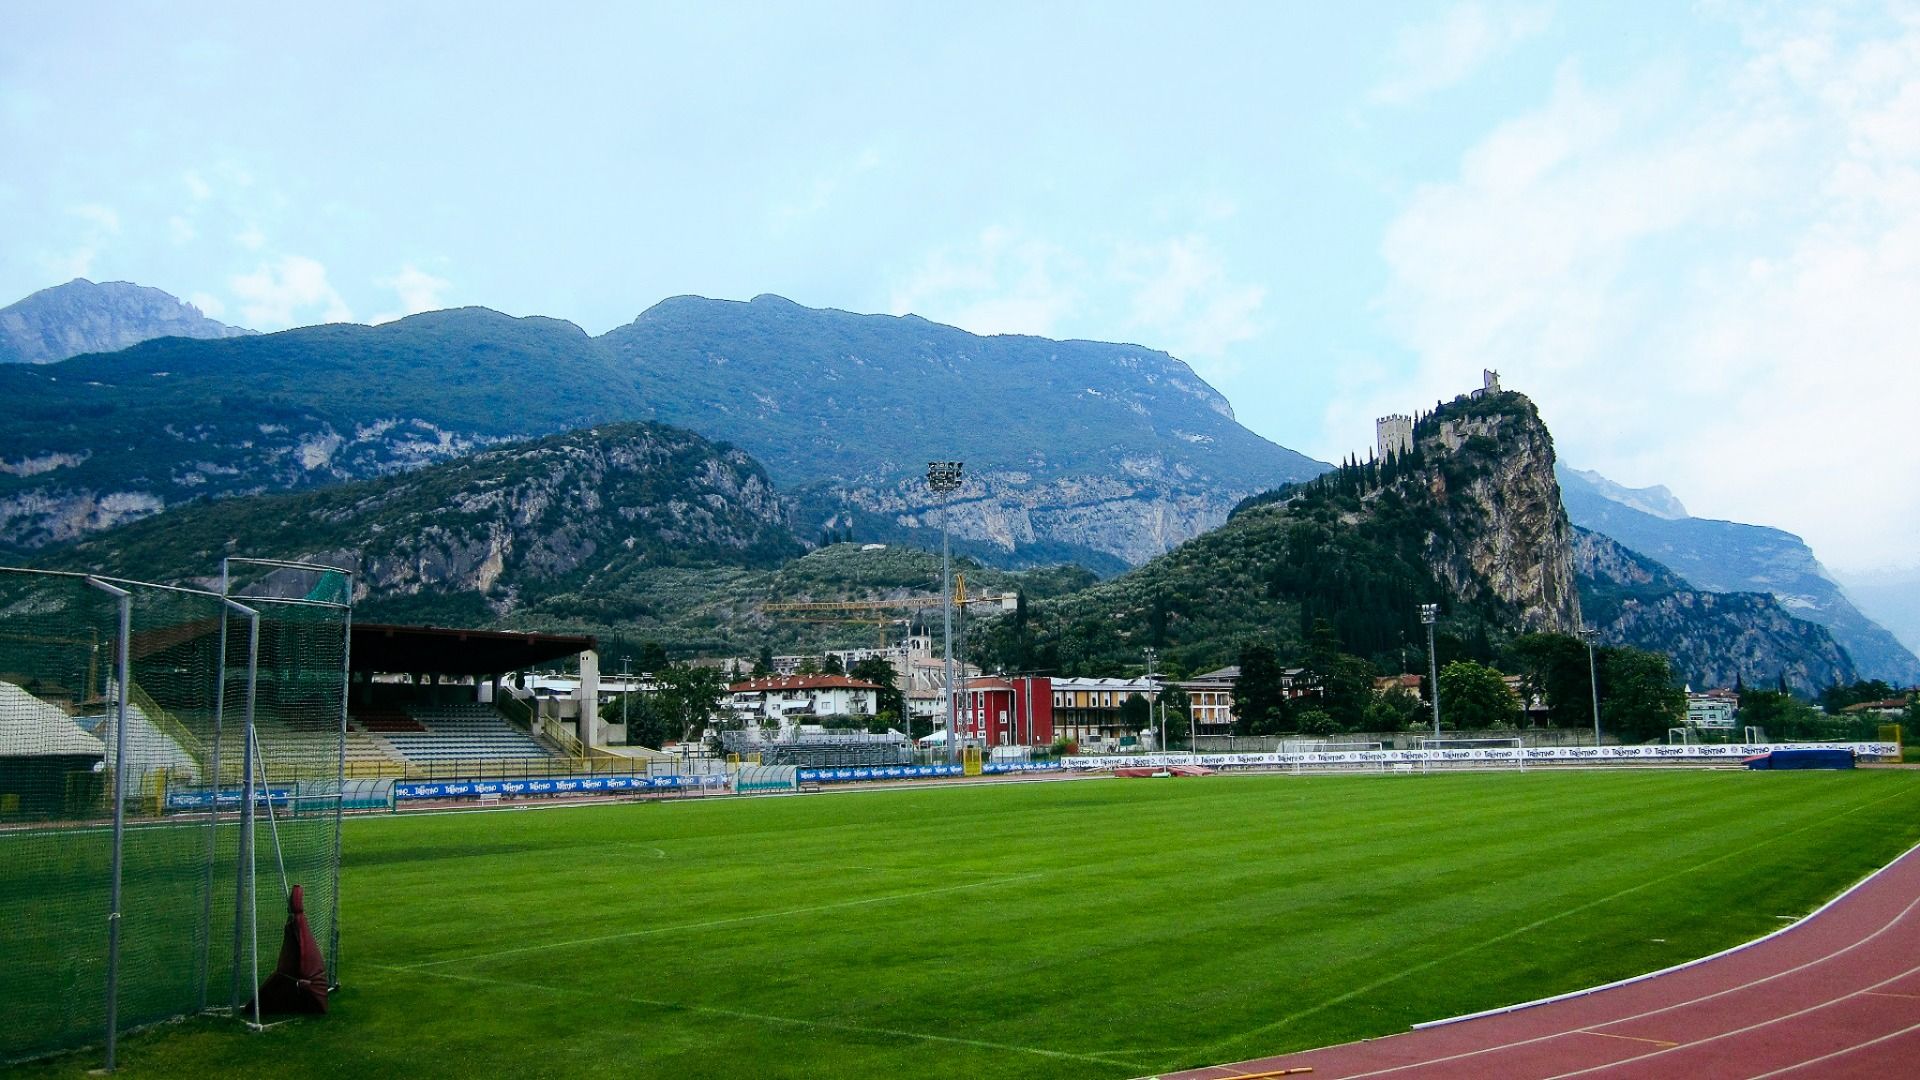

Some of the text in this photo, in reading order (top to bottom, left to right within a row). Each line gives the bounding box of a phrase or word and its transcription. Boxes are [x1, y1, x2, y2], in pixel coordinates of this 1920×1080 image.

[1526, 749, 1554, 758] TRENTINO
[1655, 747, 1683, 755] TRENTINO
[1698, 747, 1726, 755] TRENTINO
